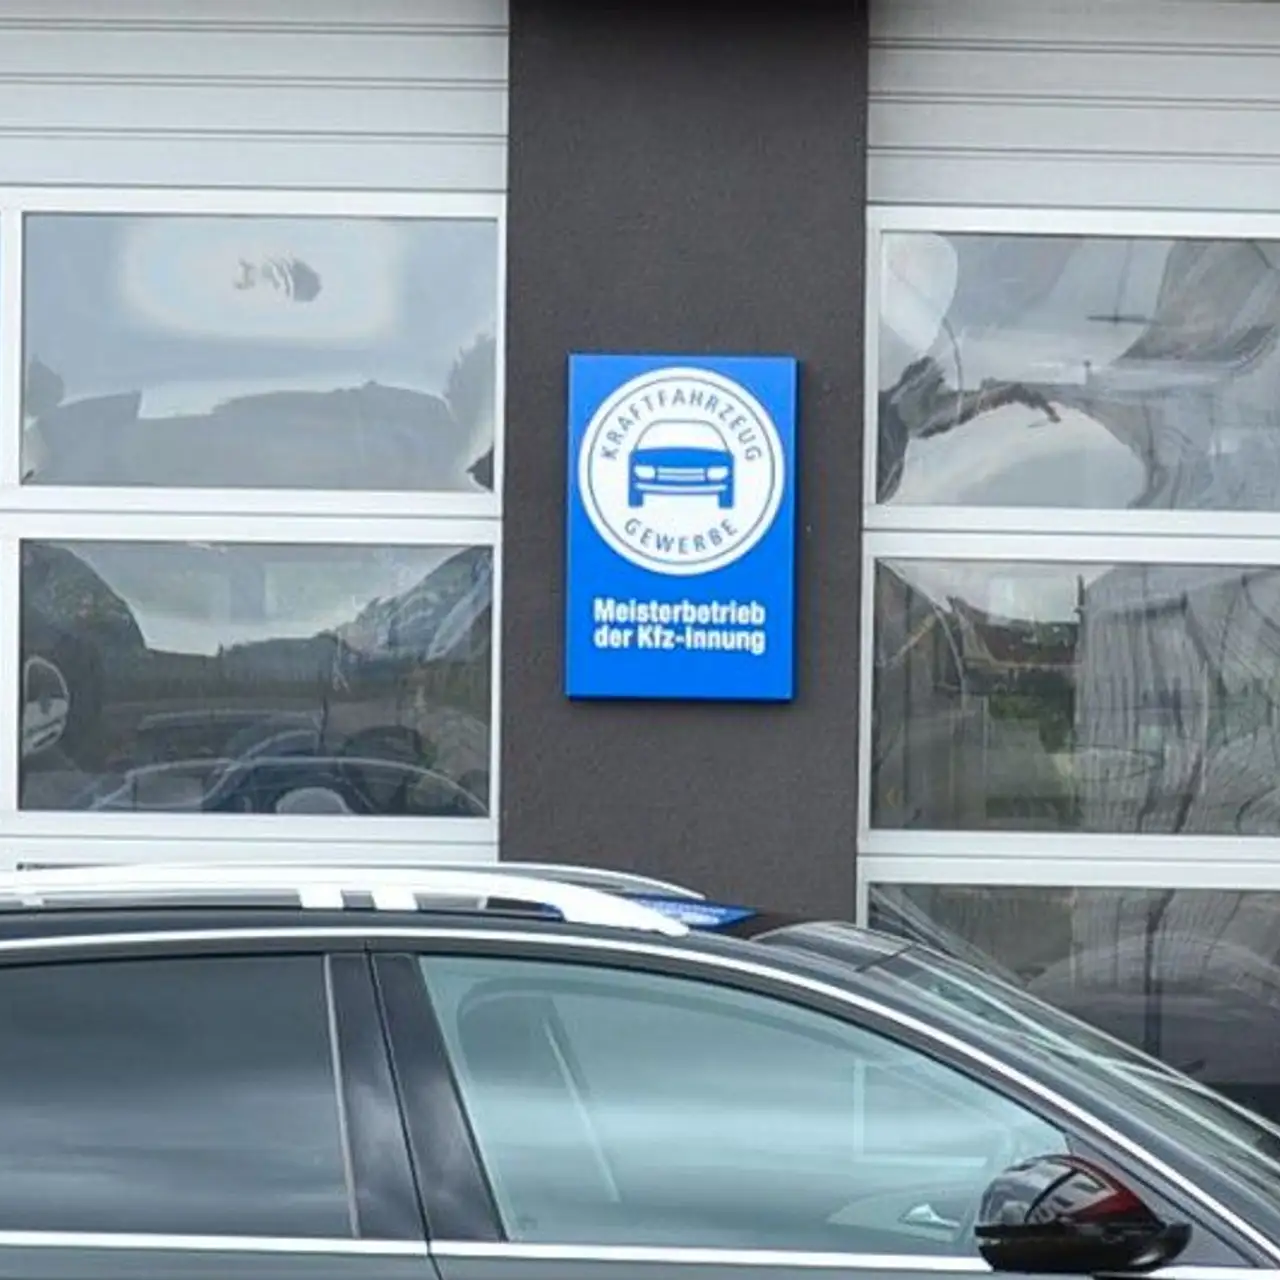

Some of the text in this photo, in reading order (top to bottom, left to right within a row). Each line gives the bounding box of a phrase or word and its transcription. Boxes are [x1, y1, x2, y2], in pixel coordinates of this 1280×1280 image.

[600, 388, 762, 462] KRAFTFAHRZEUG
[624, 517, 738, 555] GEWERBE
[593, 598, 766, 624] Meisterbetrieb
[593, 627, 766, 655] der Kfz-Innung
